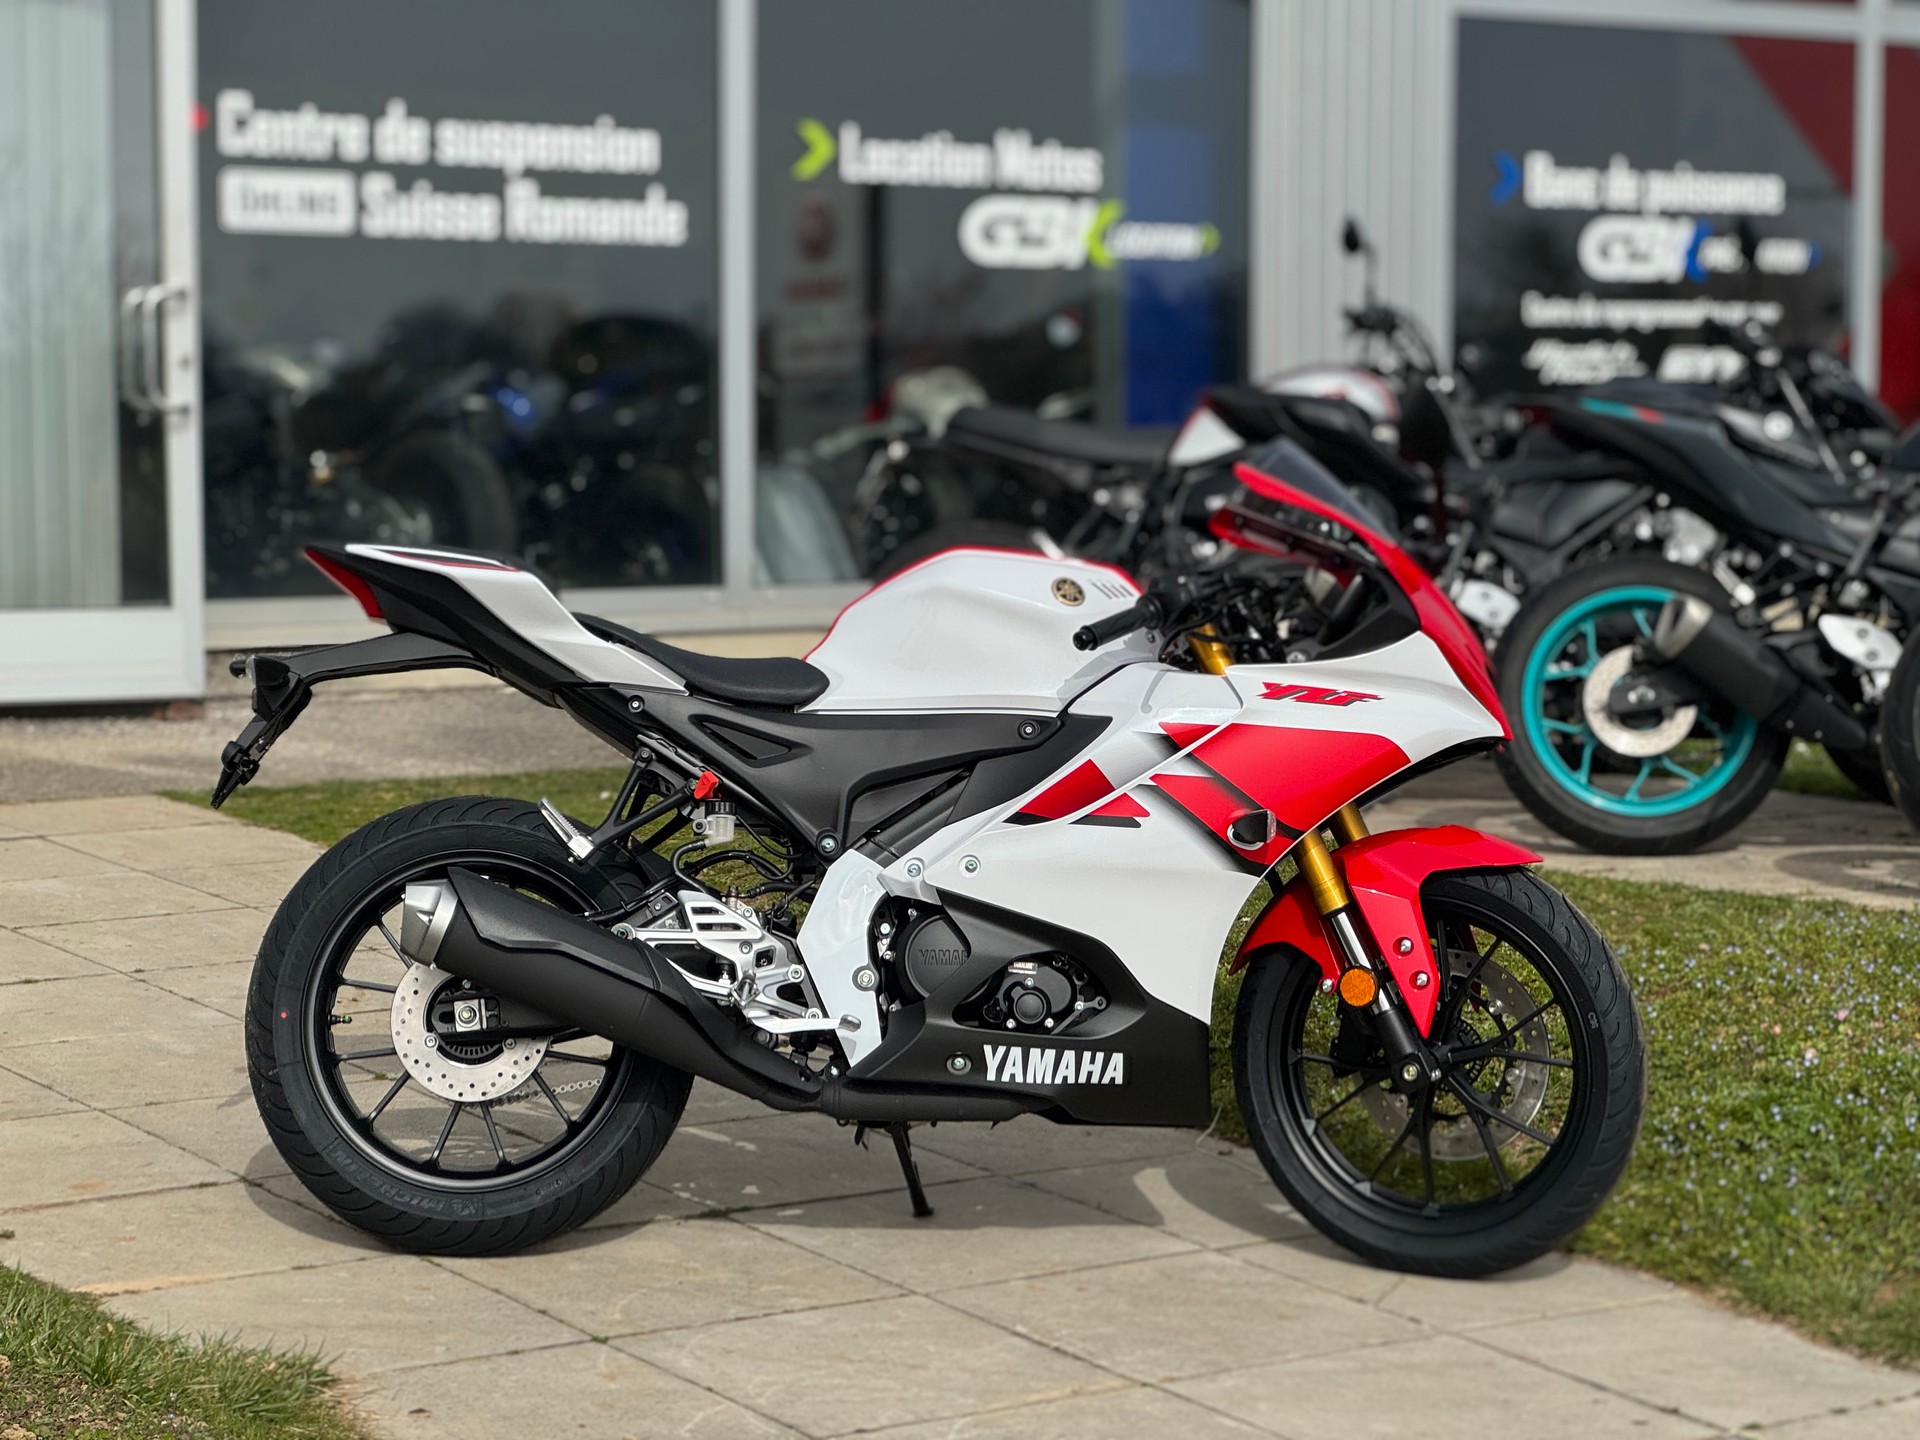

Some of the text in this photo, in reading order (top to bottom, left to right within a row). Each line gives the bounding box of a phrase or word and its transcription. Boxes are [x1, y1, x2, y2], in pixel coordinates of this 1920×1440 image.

[217, 88, 661, 178] Centre de suspension
[838, 120, 1103, 192] Location Motos
[360, 171, 500, 241] Suisse
[505, 177, 688, 247] Romande
[1600, 153, 1640, 211] de
[983, 1045, 1124, 1085] YAMAHA
